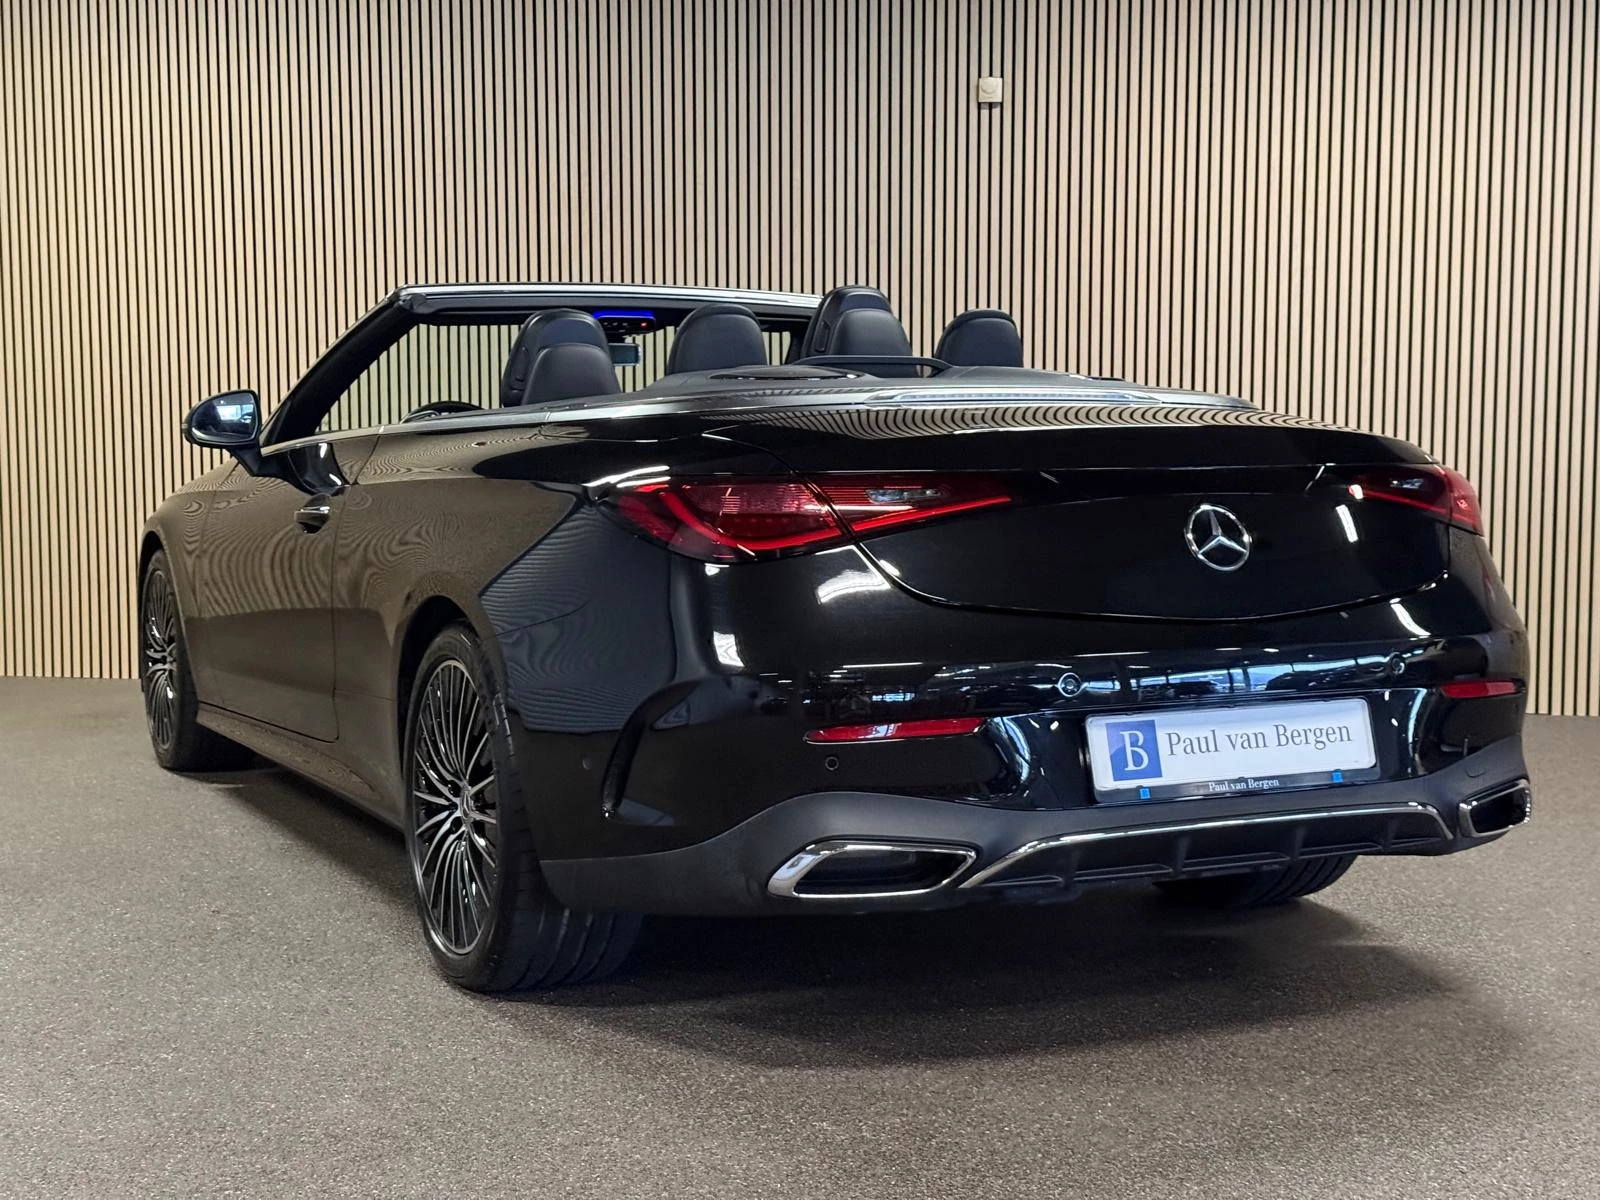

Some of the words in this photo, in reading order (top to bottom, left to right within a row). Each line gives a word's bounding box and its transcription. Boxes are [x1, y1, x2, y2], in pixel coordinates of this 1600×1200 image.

[1120, 730, 1149, 771] B
[1166, 729, 1220, 756] Paul
[1225, 731, 1269, 751] van
[1272, 724, 1353, 750] Bergen
[1208, 781, 1229, 791] Paul
[1230, 782, 1247, 790] van
[1248, 778, 1279, 789] Bergen
